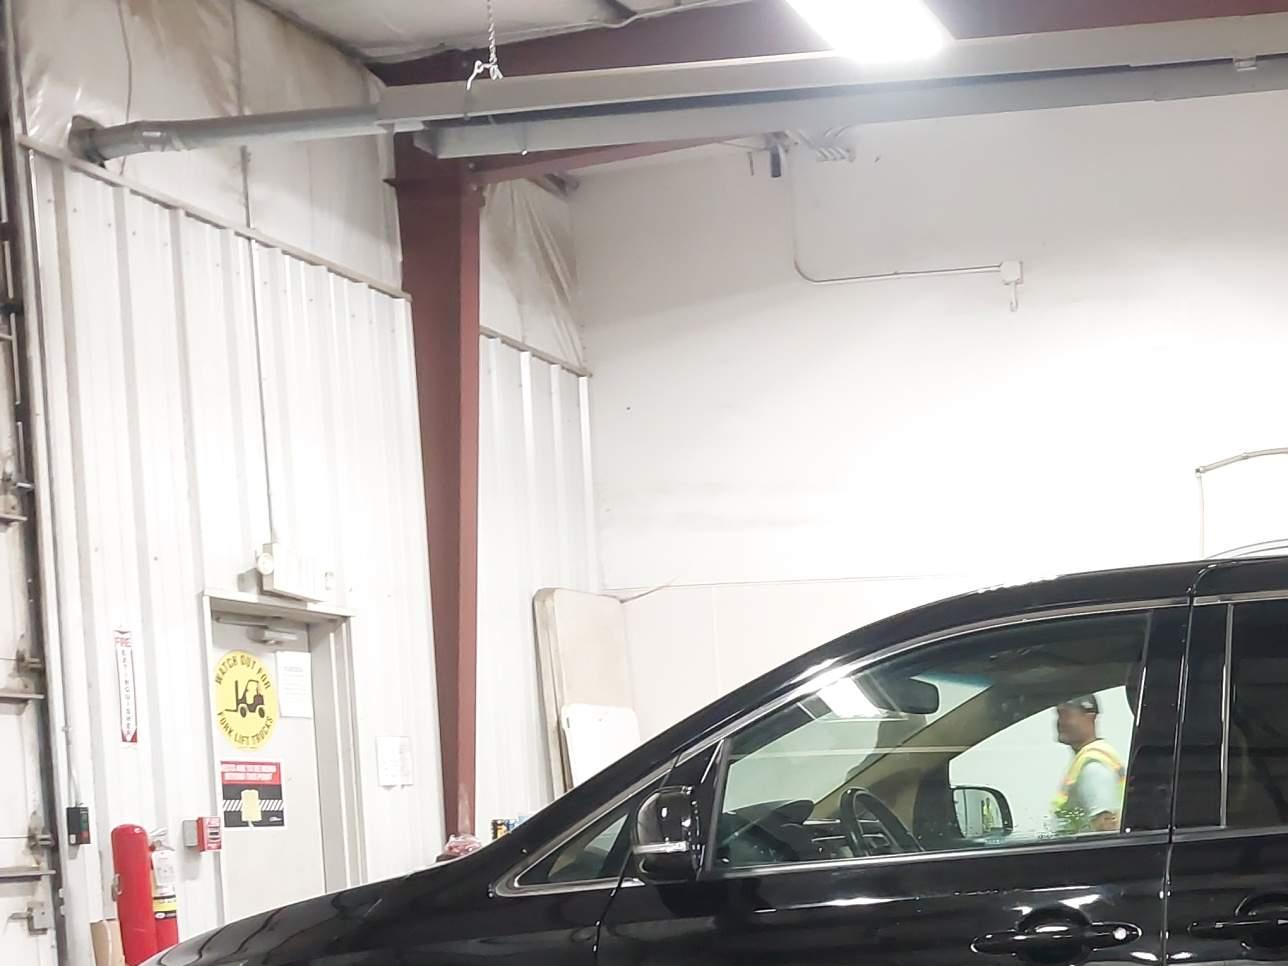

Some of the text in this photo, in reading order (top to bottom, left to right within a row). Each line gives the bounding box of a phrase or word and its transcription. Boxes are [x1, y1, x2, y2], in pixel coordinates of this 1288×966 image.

[215, 656, 238, 685] WATCH
[240, 654, 257, 670] OUT
[256, 666, 271, 689] FOR
[216, 711, 273, 746] FORK LIFT TRUCKS
